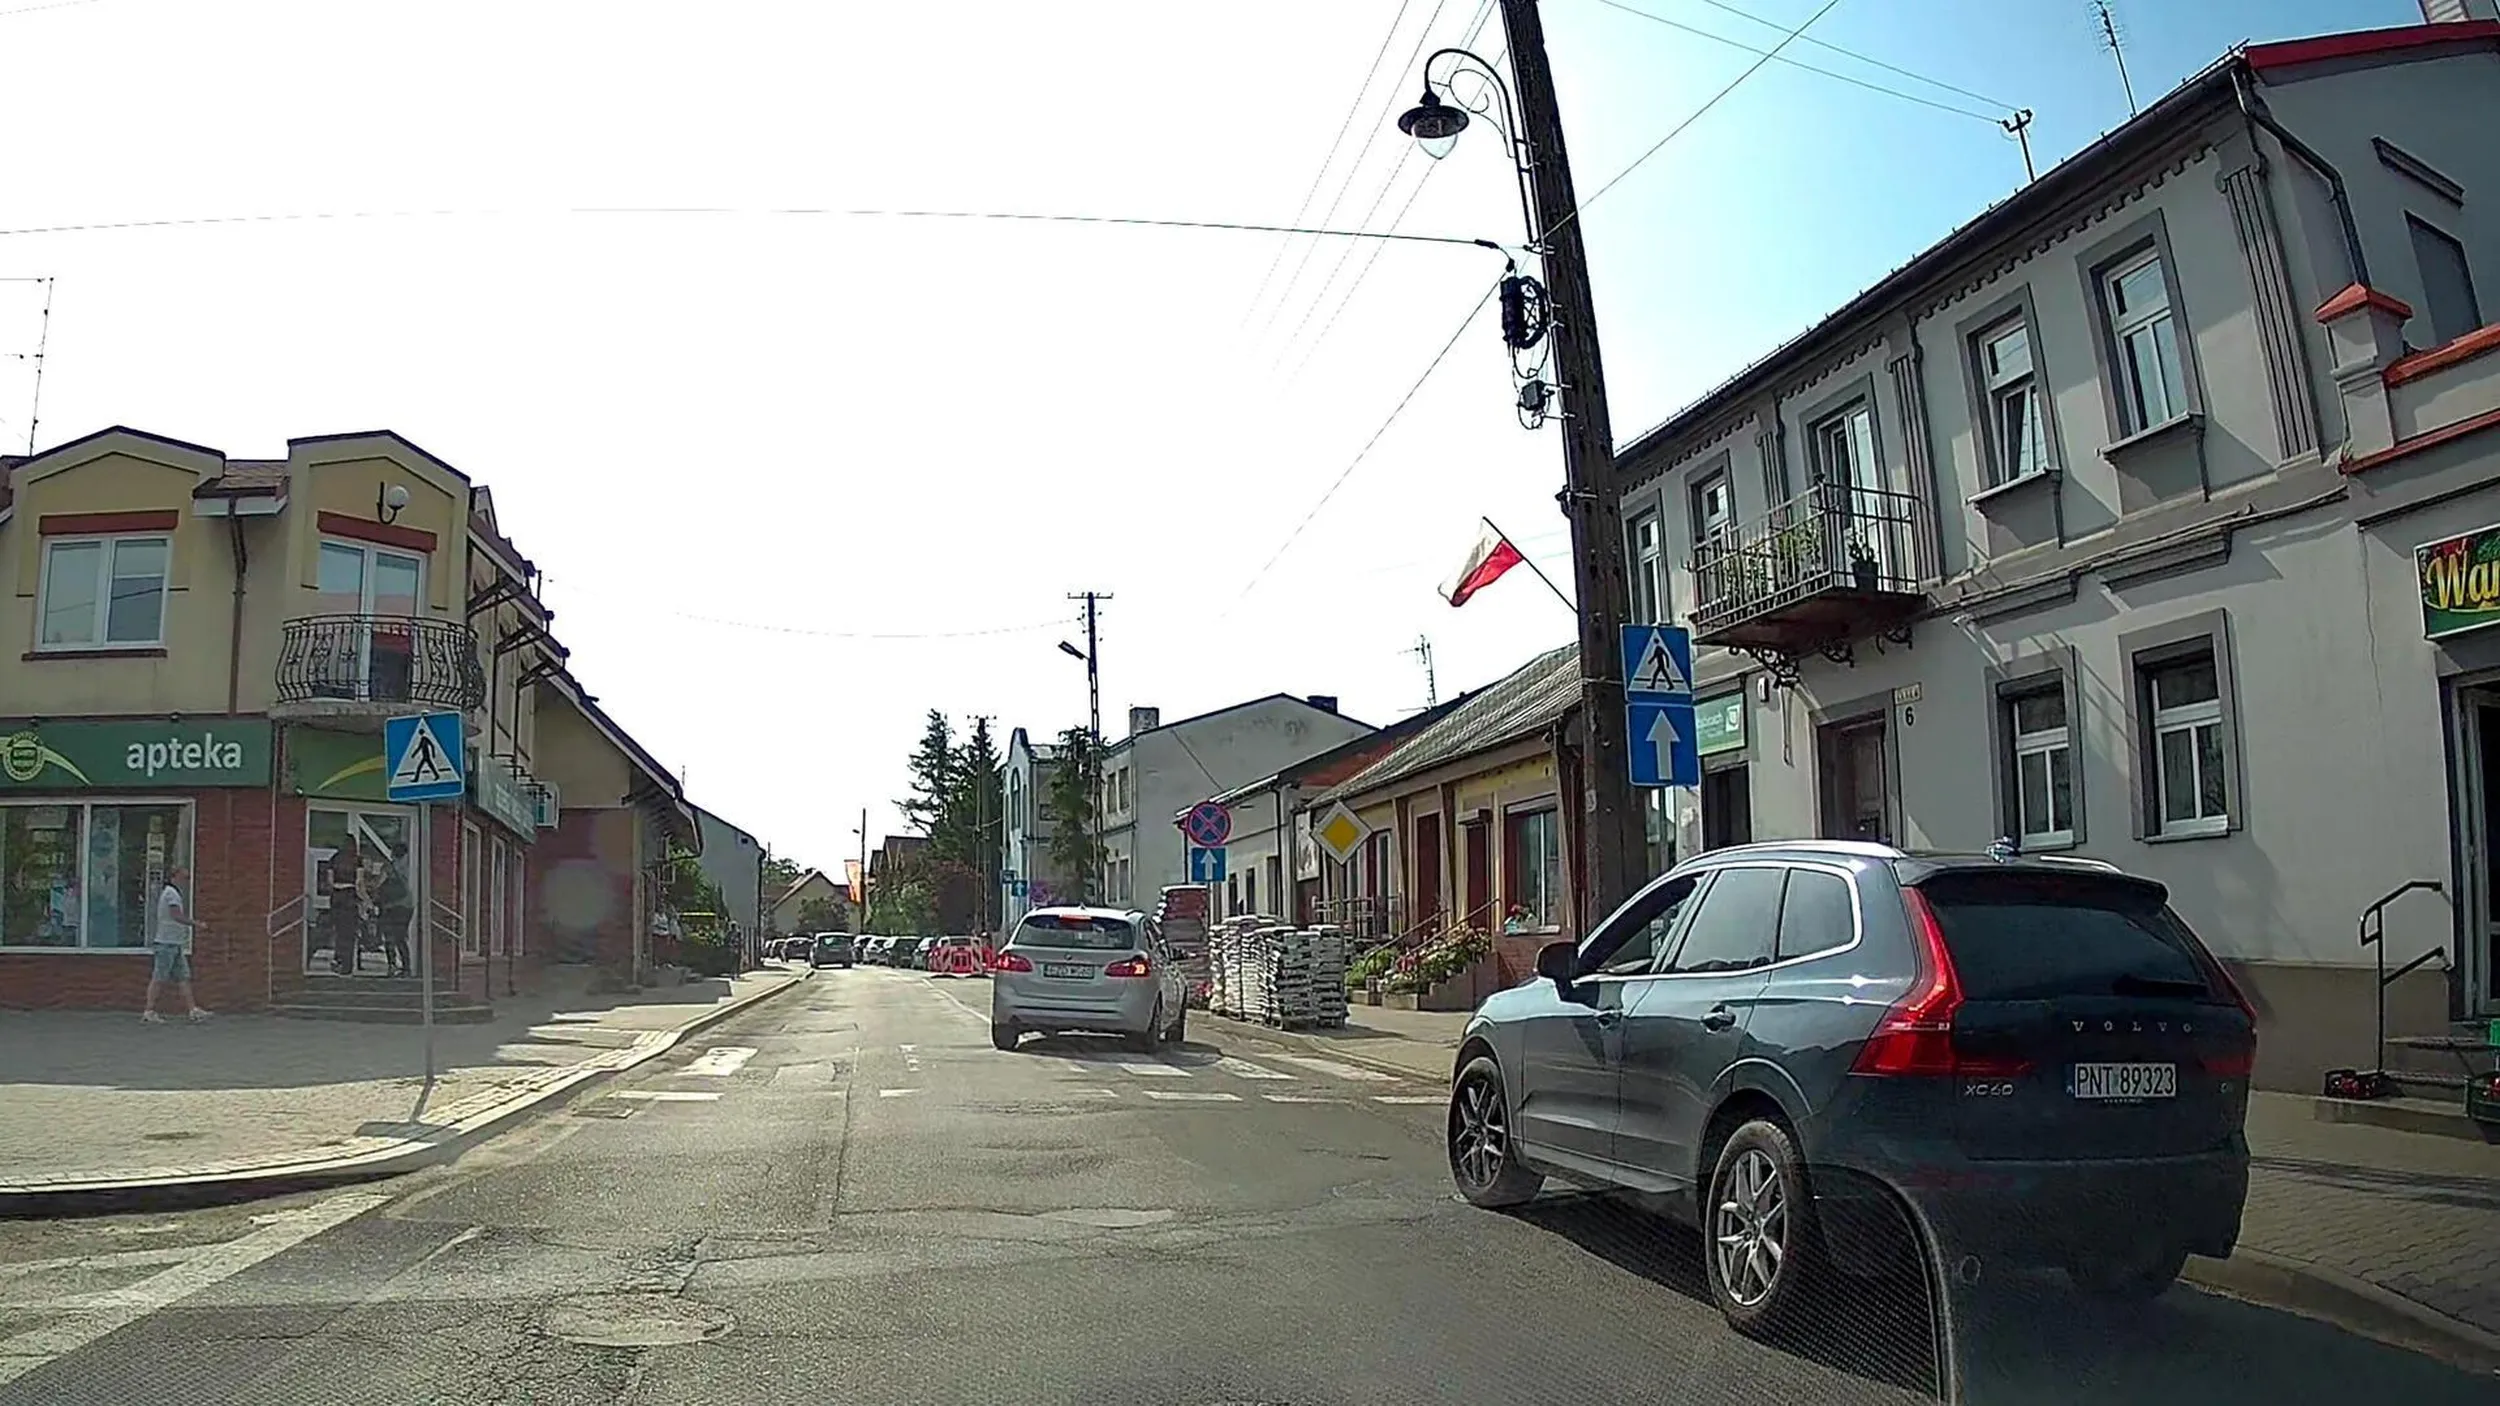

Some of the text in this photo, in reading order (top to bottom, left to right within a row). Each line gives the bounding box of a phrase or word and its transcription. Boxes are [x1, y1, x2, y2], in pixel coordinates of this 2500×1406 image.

[1905, 706, 1915, 727] 6
[126, 732, 242, 777] apteka
[2072, 1020, 2193, 1034] VOLVO
[1964, 1083, 2014, 1097] XC60
[2077, 1066, 2175, 1096] PNT 89323
